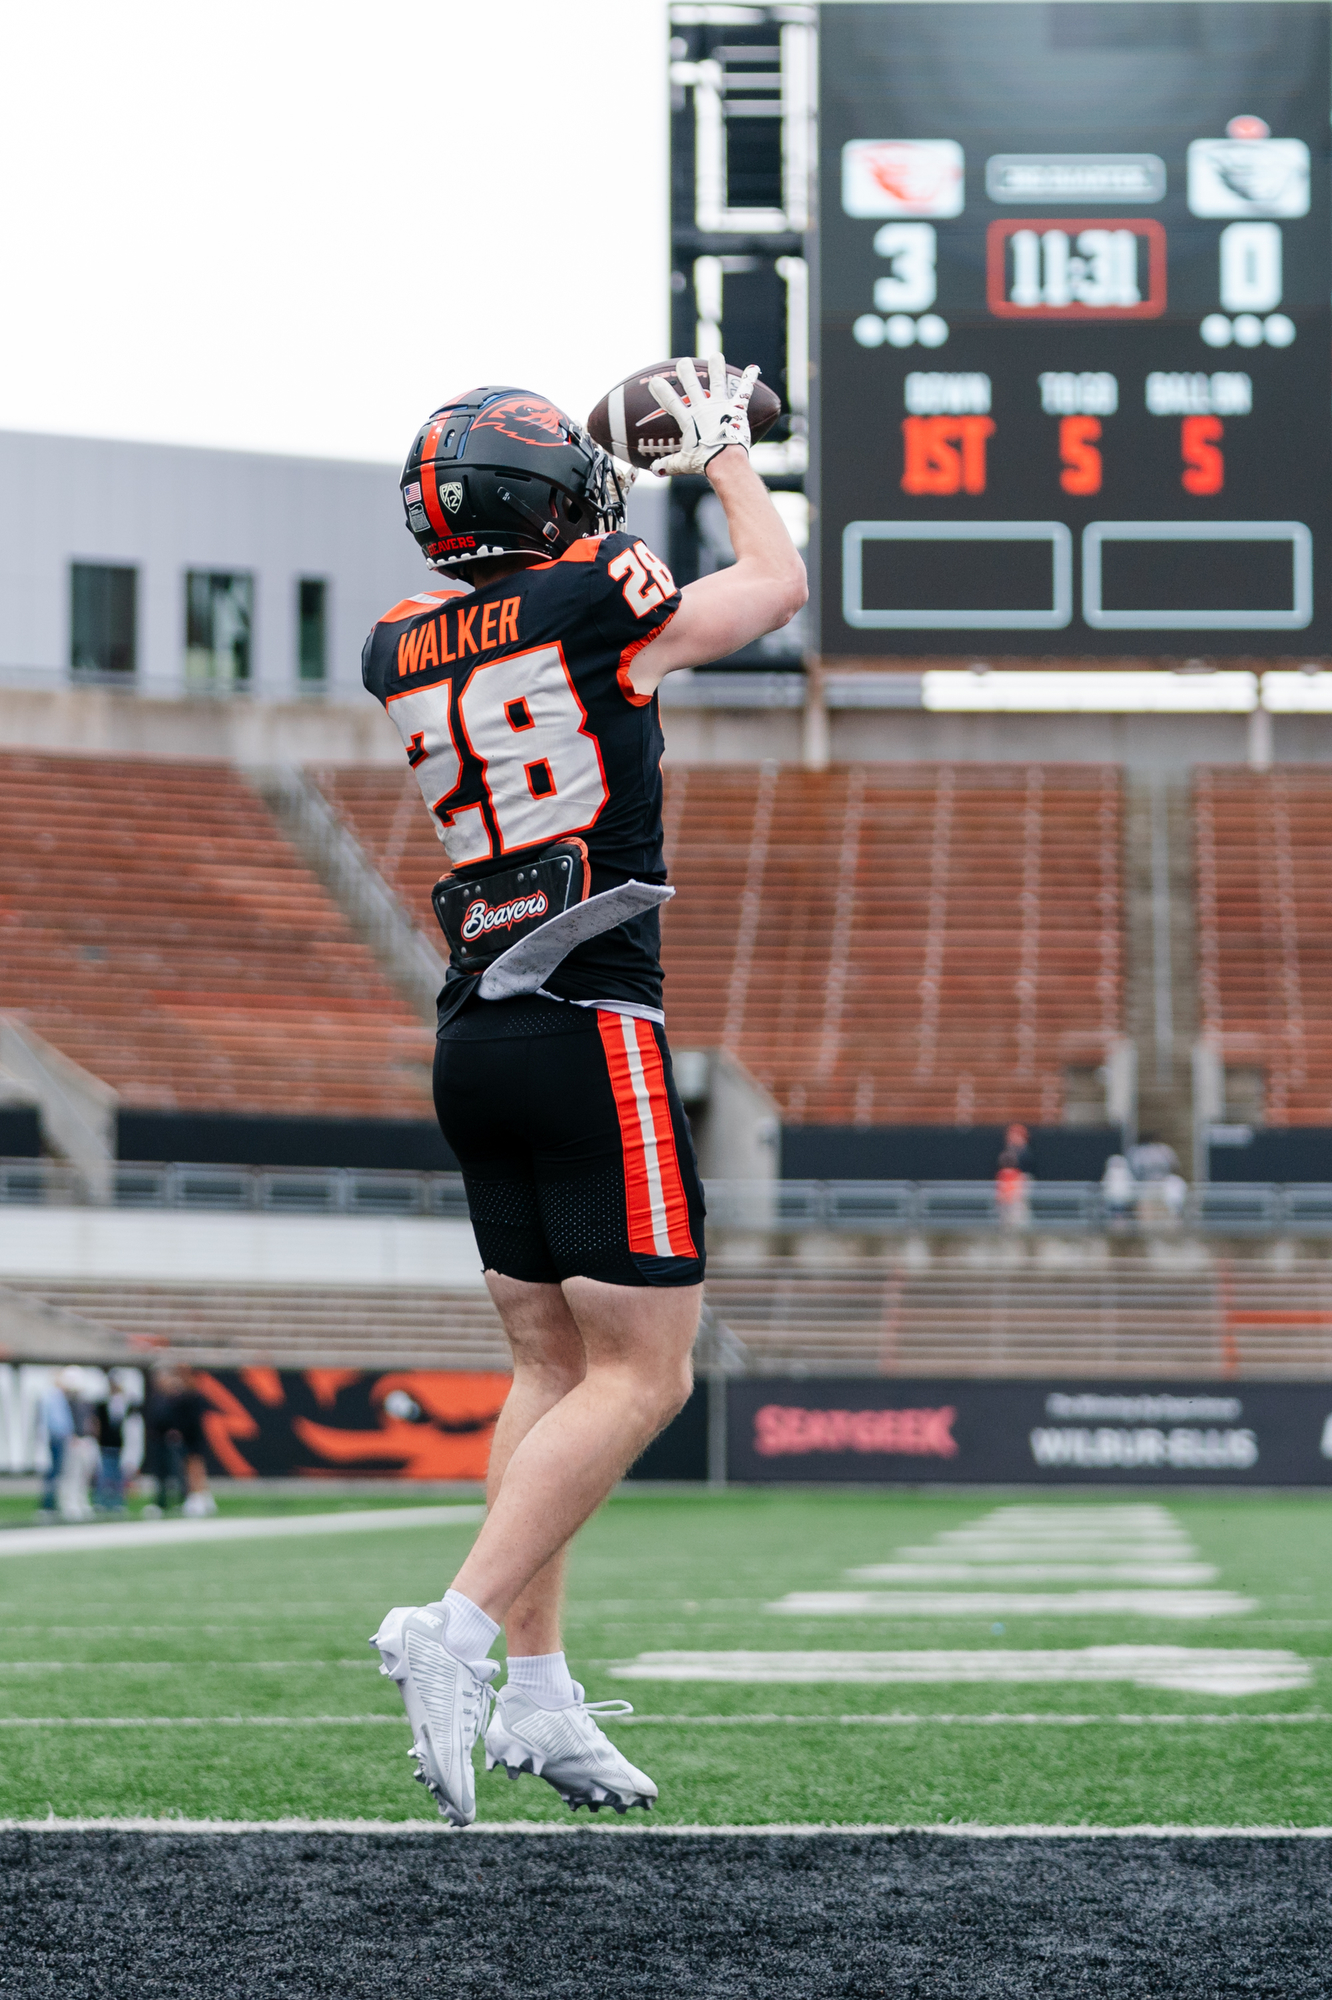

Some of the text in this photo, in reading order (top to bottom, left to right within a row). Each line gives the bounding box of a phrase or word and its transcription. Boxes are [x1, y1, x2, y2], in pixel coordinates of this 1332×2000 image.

[873, 222, 937, 313] 3
[1010, 229, 1141, 308] 11:31
[1219, 222, 1283, 313] 0
[902, 415, 996, 496] 1ST
[1059, 415, 1103, 496] 5
[1181, 415, 1225, 496] 5
[446, 495, 459, 508] 12
[428, 536, 476, 557] BEAVERS
[607, 539, 678, 619] 28
[397, 596, 521, 677] WALKER
[386, 640, 610, 868] 28
[461, 889, 549, 942] Beavers
[412, 1610, 443, 1629] NIKE
